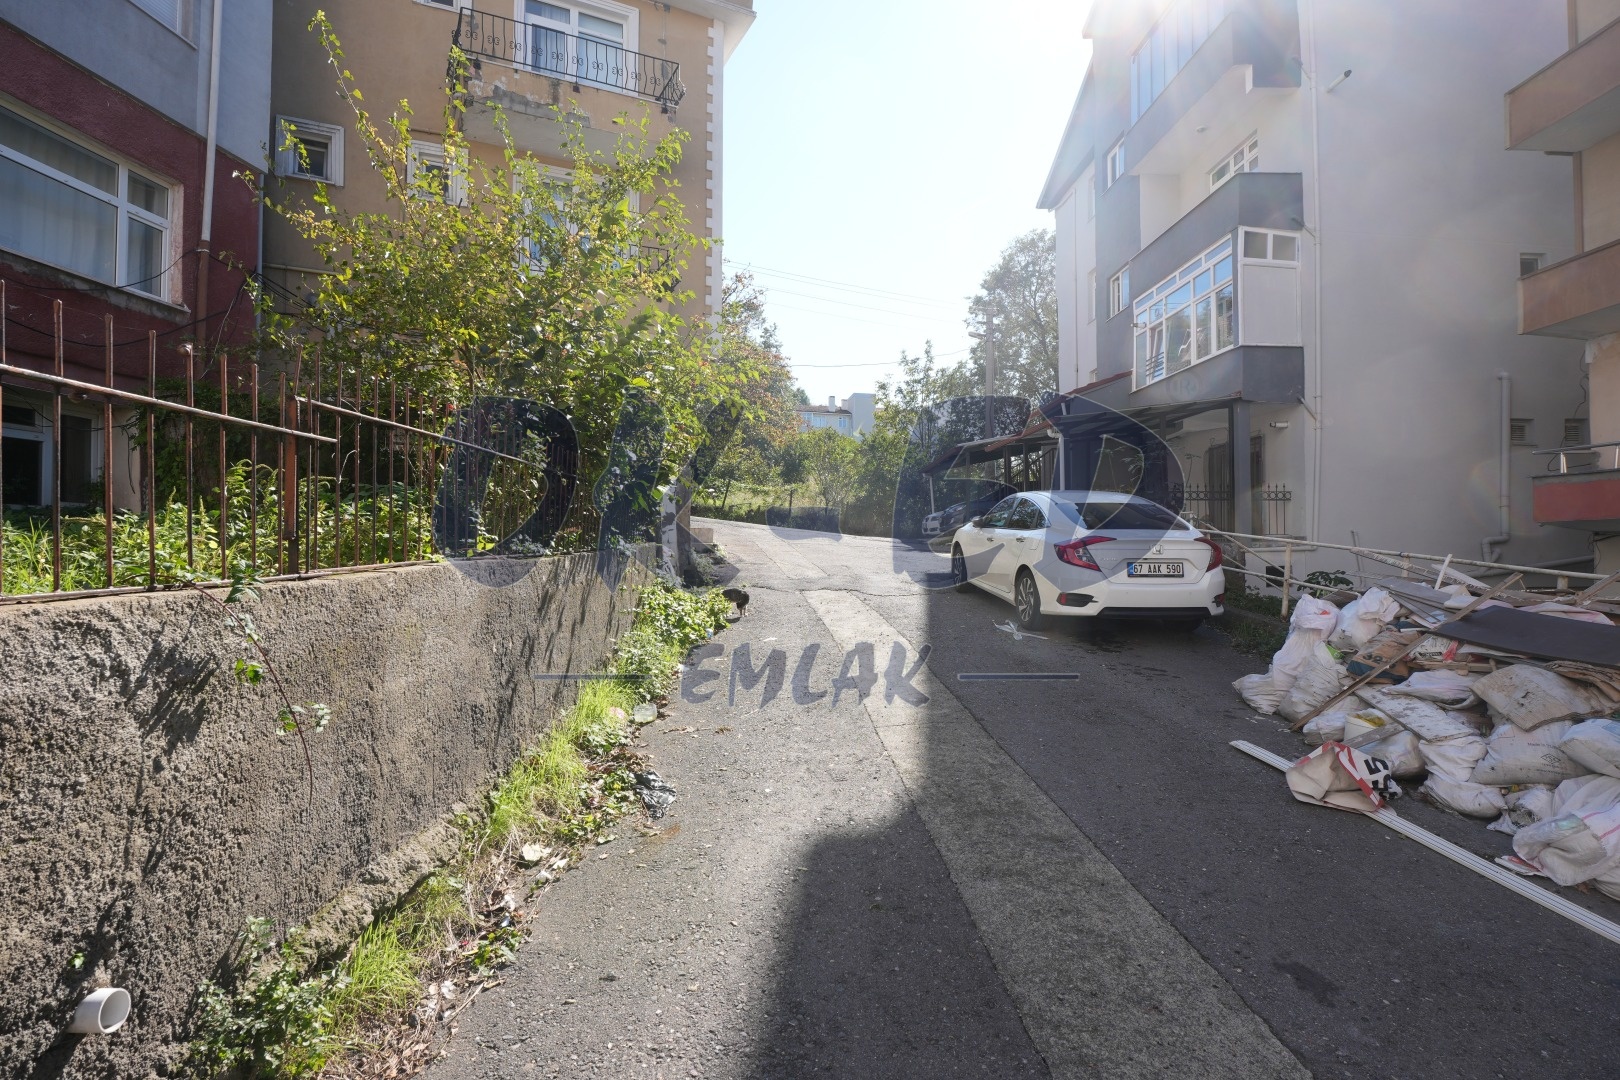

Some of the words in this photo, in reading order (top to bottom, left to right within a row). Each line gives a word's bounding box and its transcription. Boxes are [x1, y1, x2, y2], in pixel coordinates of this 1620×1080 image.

[1133, 564, 1143, 574] 67
[1147, 564, 1162, 574] AAK
[1166, 564, 1181, 574] 590
